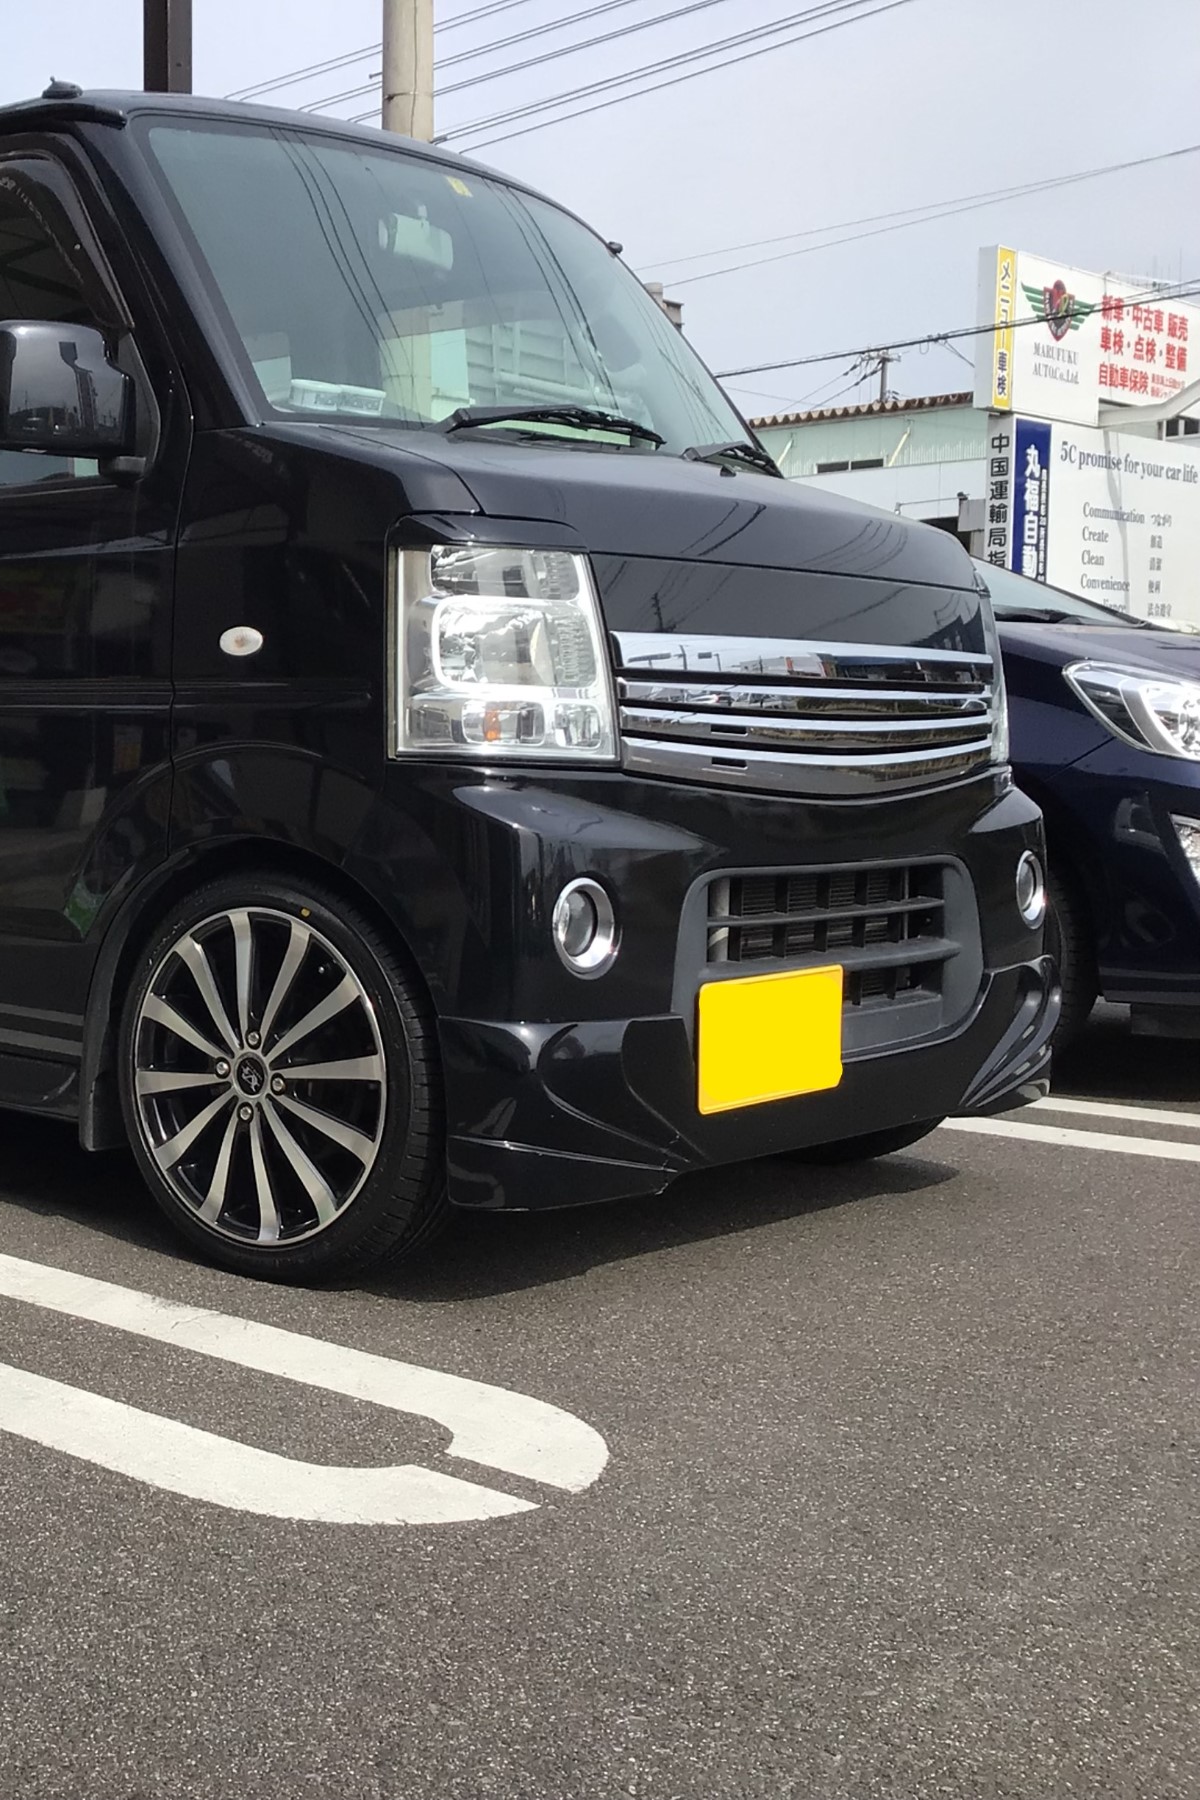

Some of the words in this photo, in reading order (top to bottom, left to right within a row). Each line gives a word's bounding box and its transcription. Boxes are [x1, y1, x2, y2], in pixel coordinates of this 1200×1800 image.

[1033, 342, 1079, 365] MARUFUKU
[1098, 361, 1149, 395] 自動車保険
[1060, 440, 1077, 464] 5C
[1078, 450, 1122, 470] promise
[1124, 453, 1140, 474] for
[1140, 462, 1164, 479] your
[1166, 466, 1182, 481] car
[1183, 463, 1198, 483] life
[1083, 502, 1145, 524] Communication
[1082, 526, 1109, 543] Create
[1081, 549, 1104, 566] Clean
[1080, 573, 1130, 592] Convenience
